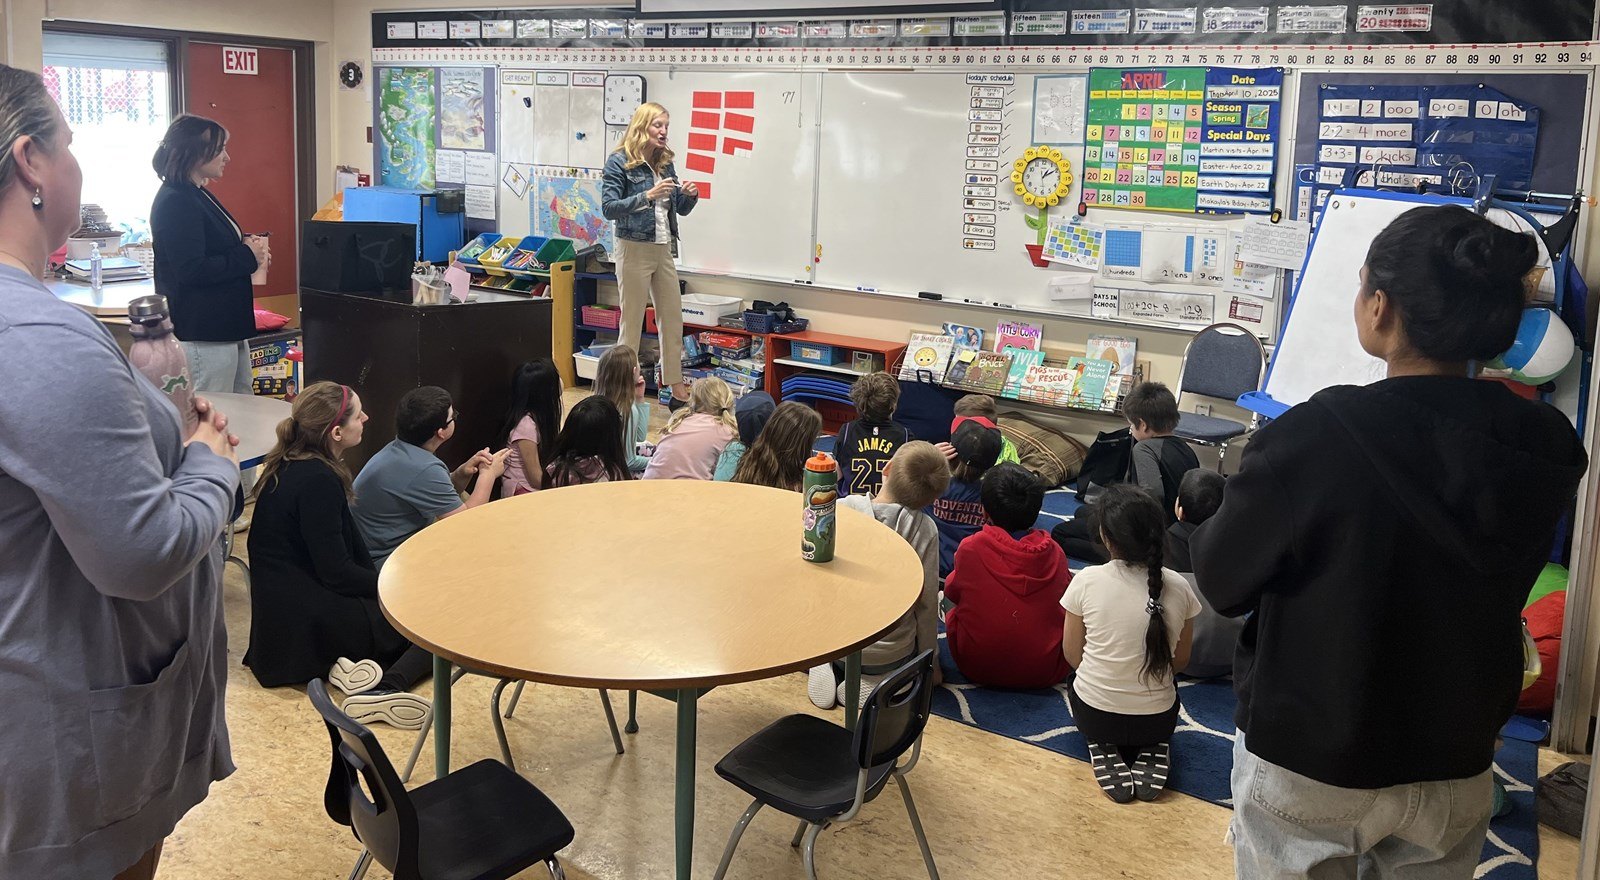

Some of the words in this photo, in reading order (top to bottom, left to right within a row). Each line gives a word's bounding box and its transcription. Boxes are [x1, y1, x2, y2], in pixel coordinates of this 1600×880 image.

[1015, 22, 1025, 32] 15
[1075, 21, 1085, 30] 16
[1139, 20, 1148, 30] 17
[1208, 20, 1217, 30] 18
[1360, 17, 1378, 28] 20
[225, 50, 256, 71] EXIT
[1251, 55, 1260, 63] 78
[1270, 55, 1279, 63] 79
[1288, 55, 1297, 64] 80
[1306, 55, 1314, 64] 81
[1325, 55, 1334, 64] 82
[1344, 56, 1354, 64] 83
[1363, 56, 1373, 64] 84
[1385, 55, 1395, 64] 85
[1405, 55, 1415, 64] 86
[1426, 55, 1436, 64] 87
[1446, 55, 1457, 64] 88
[1468, 55, 1478, 64] 89
[1489, 55, 1500, 64] 90
[1513, 54, 1523, 63] 91
[1535, 53, 1547, 63] 92
[1558, 53, 1569, 62] 93
[1580, 52, 1591, 62] 94
[348, 69, 354, 81] 3
[1122, 72, 1164, 89] APRIL
[1231, 75, 1255, 84] Date
[1142, 107, 1147, 115] 2
[1158, 107, 1163, 115] 3
[1174, 107, 1180, 115] 4
[1191, 108, 1197, 116] 5
[1206, 102, 1242, 112] Season
[1365, 103, 1375, 114] 2
[1213, 115, 1236, 123] Spring
[1091, 128, 1097, 136] 6
[1110, 129, 1115, 137] 7
[1125, 129, 1130, 137] 8
[1140, 129, 1145, 137] 9
[1153, 130, 1163, 138] 10
[1172, 130, 1179, 139] 11
[1188, 130, 1197, 139] 12
[1207, 130, 1243, 141] Special
[1246, 131, 1271, 142] Days
[1359, 126, 1368, 138] 4
[1088, 150, 1097, 158] 13
[1105, 150, 1114, 158] 14
[1121, 151, 1130, 159] 15
[1136, 152, 1145, 160] 16
[1153, 153, 1162, 161] 17
[1169, 154, 1178, 162] 18
[1186, 154, 1195, 163] 19
[1365, 150, 1373, 161] 6
[1380, 150, 1411, 161] kicks
[1087, 172, 1097, 180] 20
[1103, 173, 1111, 181] 21
[1118, 174, 1129, 182] 22
[1134, 175, 1145, 183] 23
[1150, 175, 1161, 183] 24
[1166, 176, 1178, 184] 25
[1183, 176, 1195, 184] 26
[1201, 180, 1223, 188] Earth
[1085, 193, 1095, 201] 27
[1101, 194, 1111, 202] 28
[1117, 194, 1128, 203] 29
[1132, 196, 1143, 204] 30
[1094, 301, 1117, 309] SCHOOL
[1030, 366, 1047, 374] PIGS
[1039, 374, 1068, 384] RESCUE
[858, 438, 893, 454] JAMES
